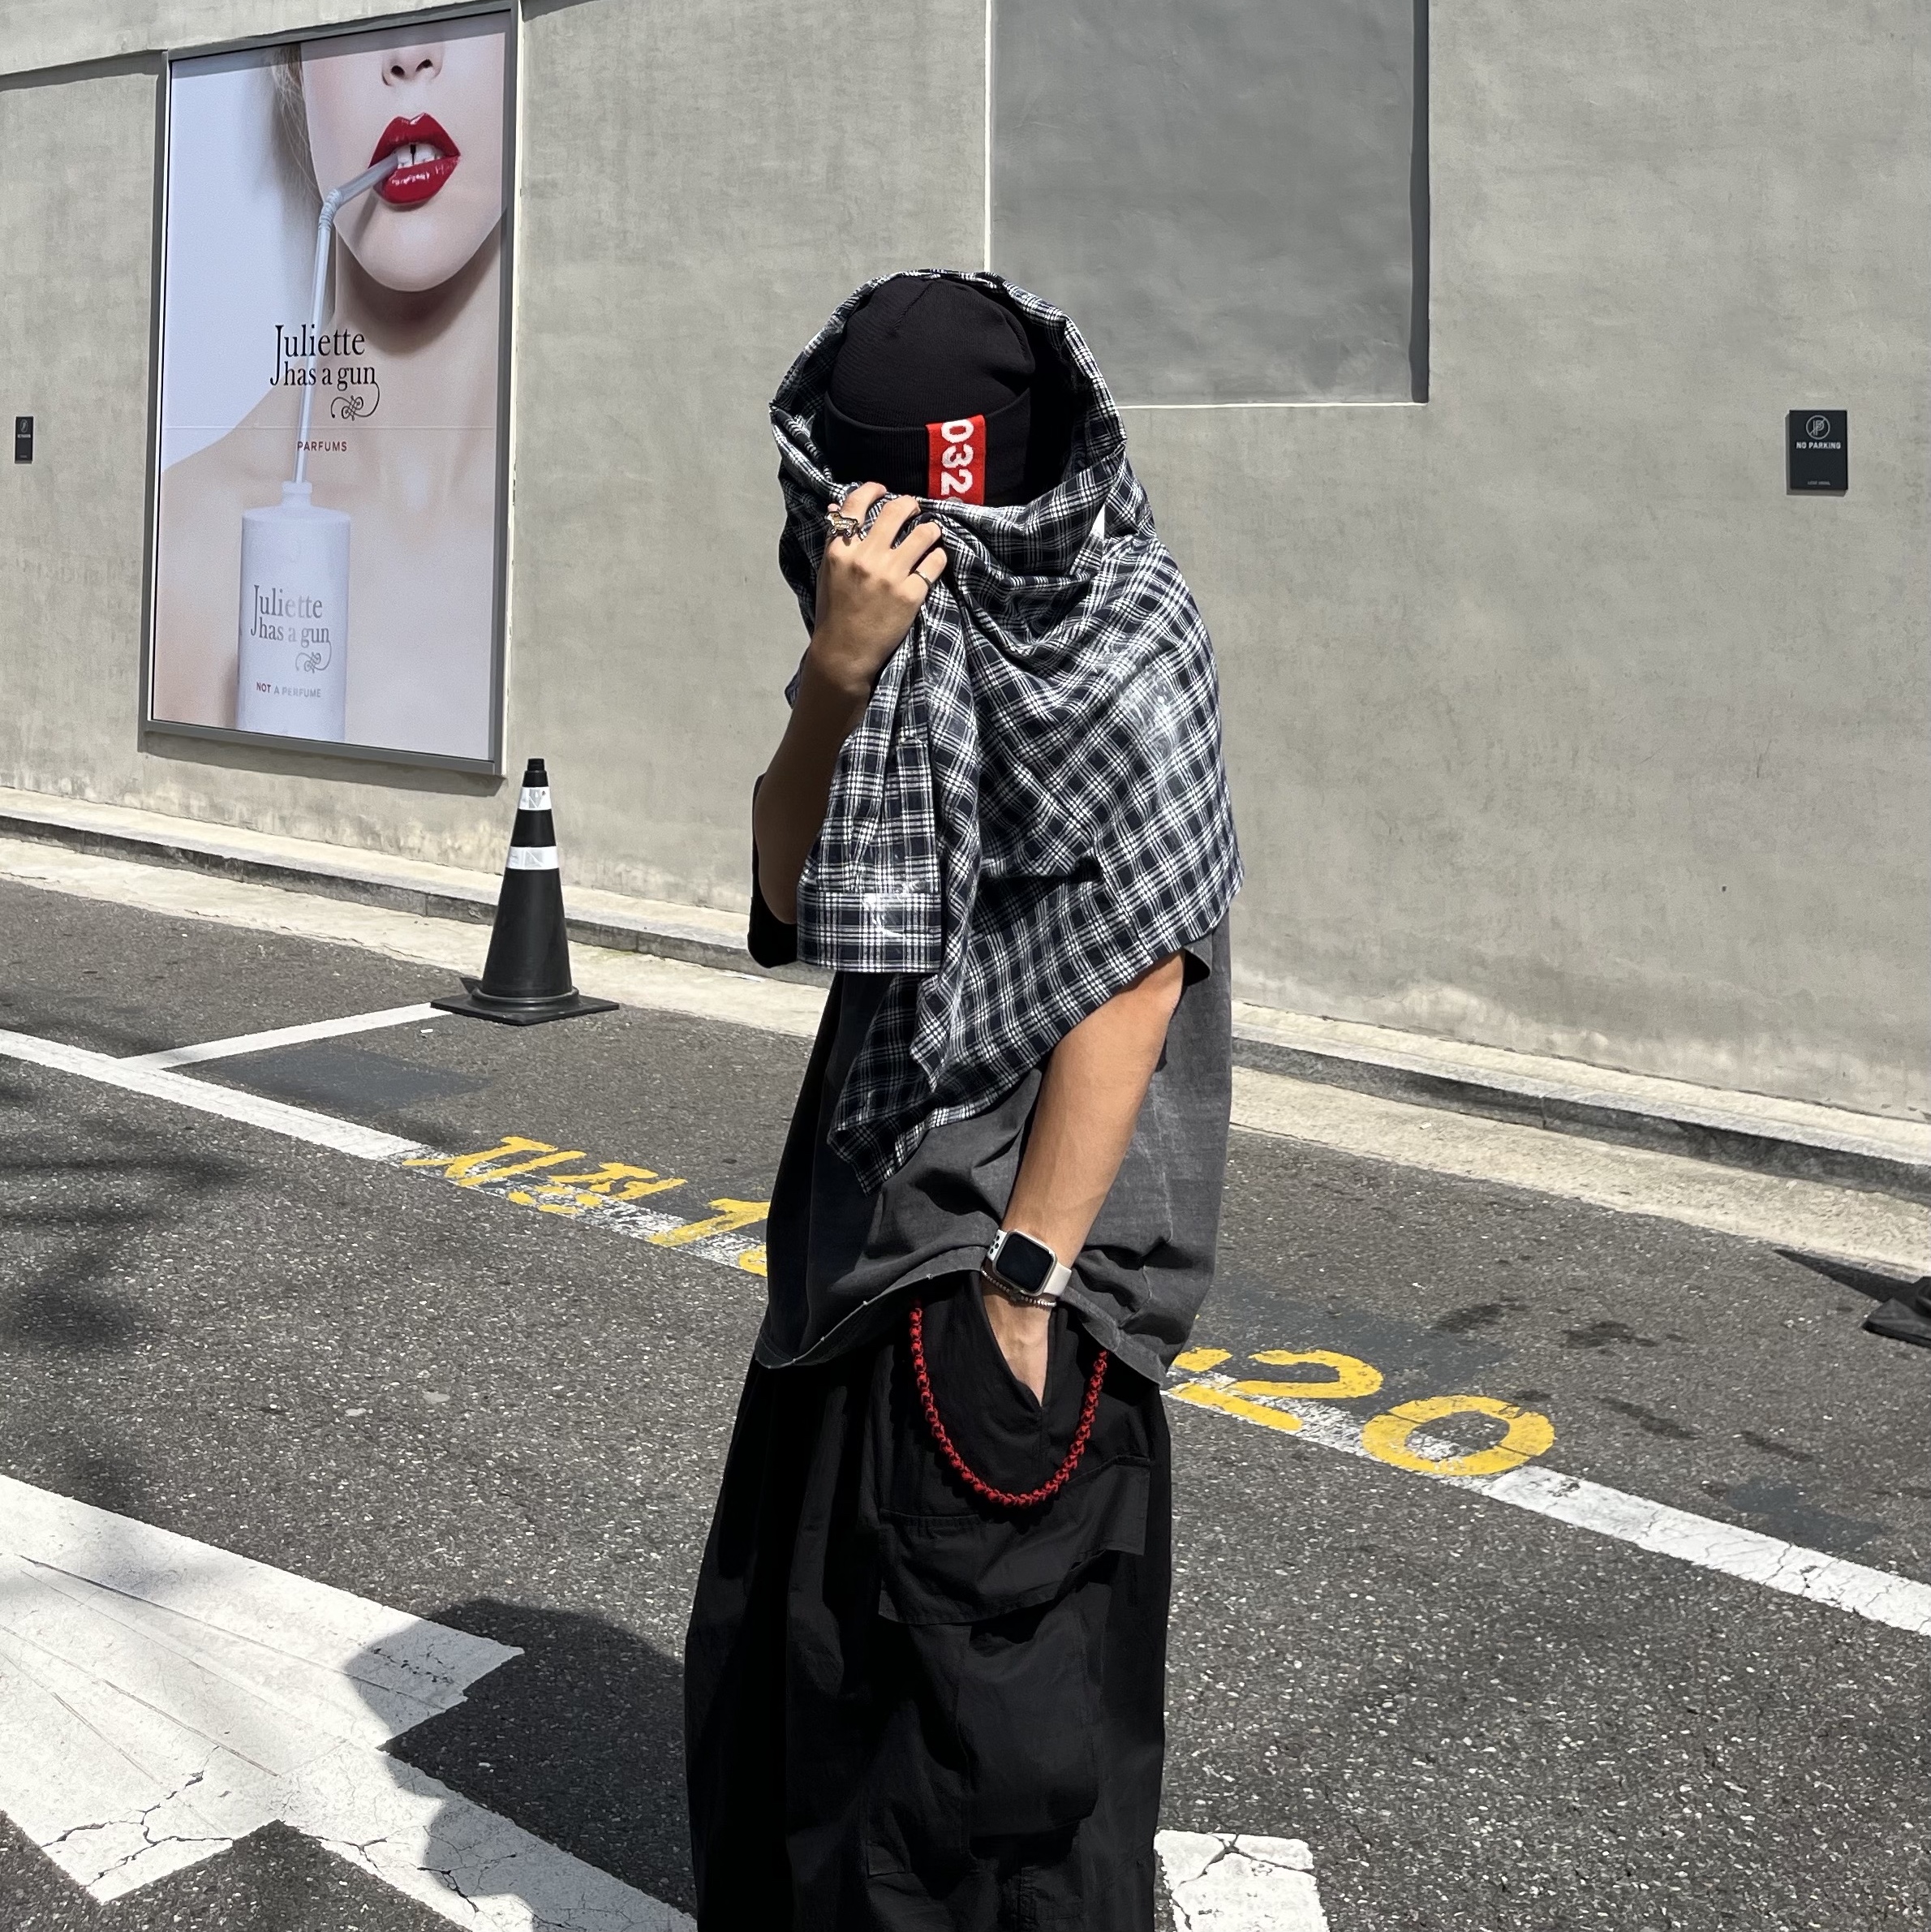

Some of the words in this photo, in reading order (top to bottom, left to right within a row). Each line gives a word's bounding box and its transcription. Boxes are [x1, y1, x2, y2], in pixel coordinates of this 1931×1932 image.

[270, 324, 365, 385] Juliette
[283, 360, 316, 386] has
[321, 367, 333, 385] a
[297, 441, 347, 452] PARFUMS
[1796, 441, 1807, 450] NO
[1808, 441, 1842, 450] PARKING
[940, 419, 974, 504] 032
[251, 584, 323, 636] Juliette
[259, 617, 285, 642] has
[288, 626, 297, 643] a
[256, 682, 272, 693] NOT
[273, 686, 280, 695] A
[282, 686, 321, 698] PERFUME
